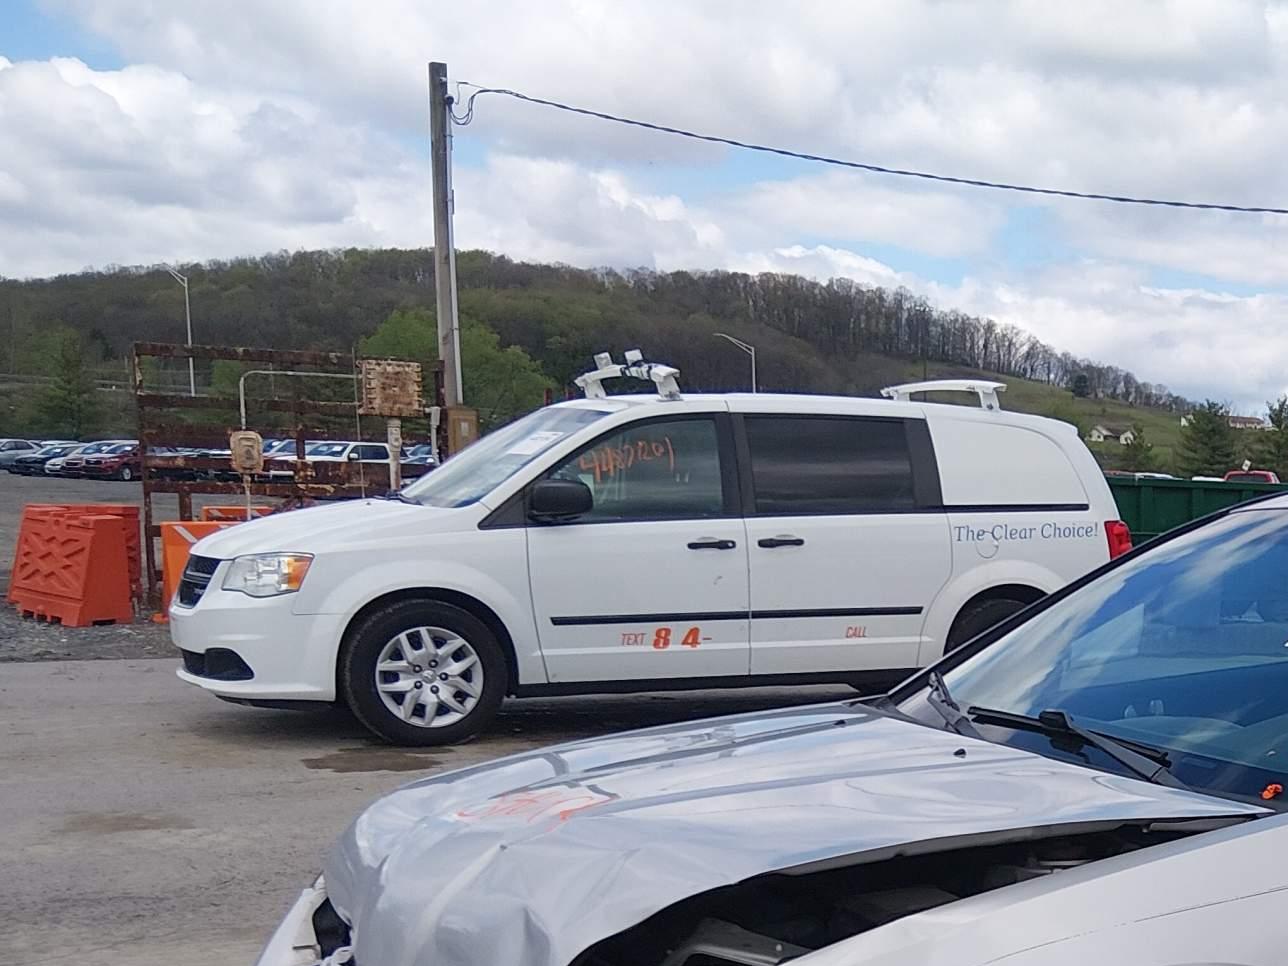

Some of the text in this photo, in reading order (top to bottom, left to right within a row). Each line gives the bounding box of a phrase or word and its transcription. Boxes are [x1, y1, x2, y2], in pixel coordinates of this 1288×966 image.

[954, 521, 1098, 542] The Clear Choice!
[621, 632, 647, 647] TEXT
[845, 626, 868, 639] CALL
